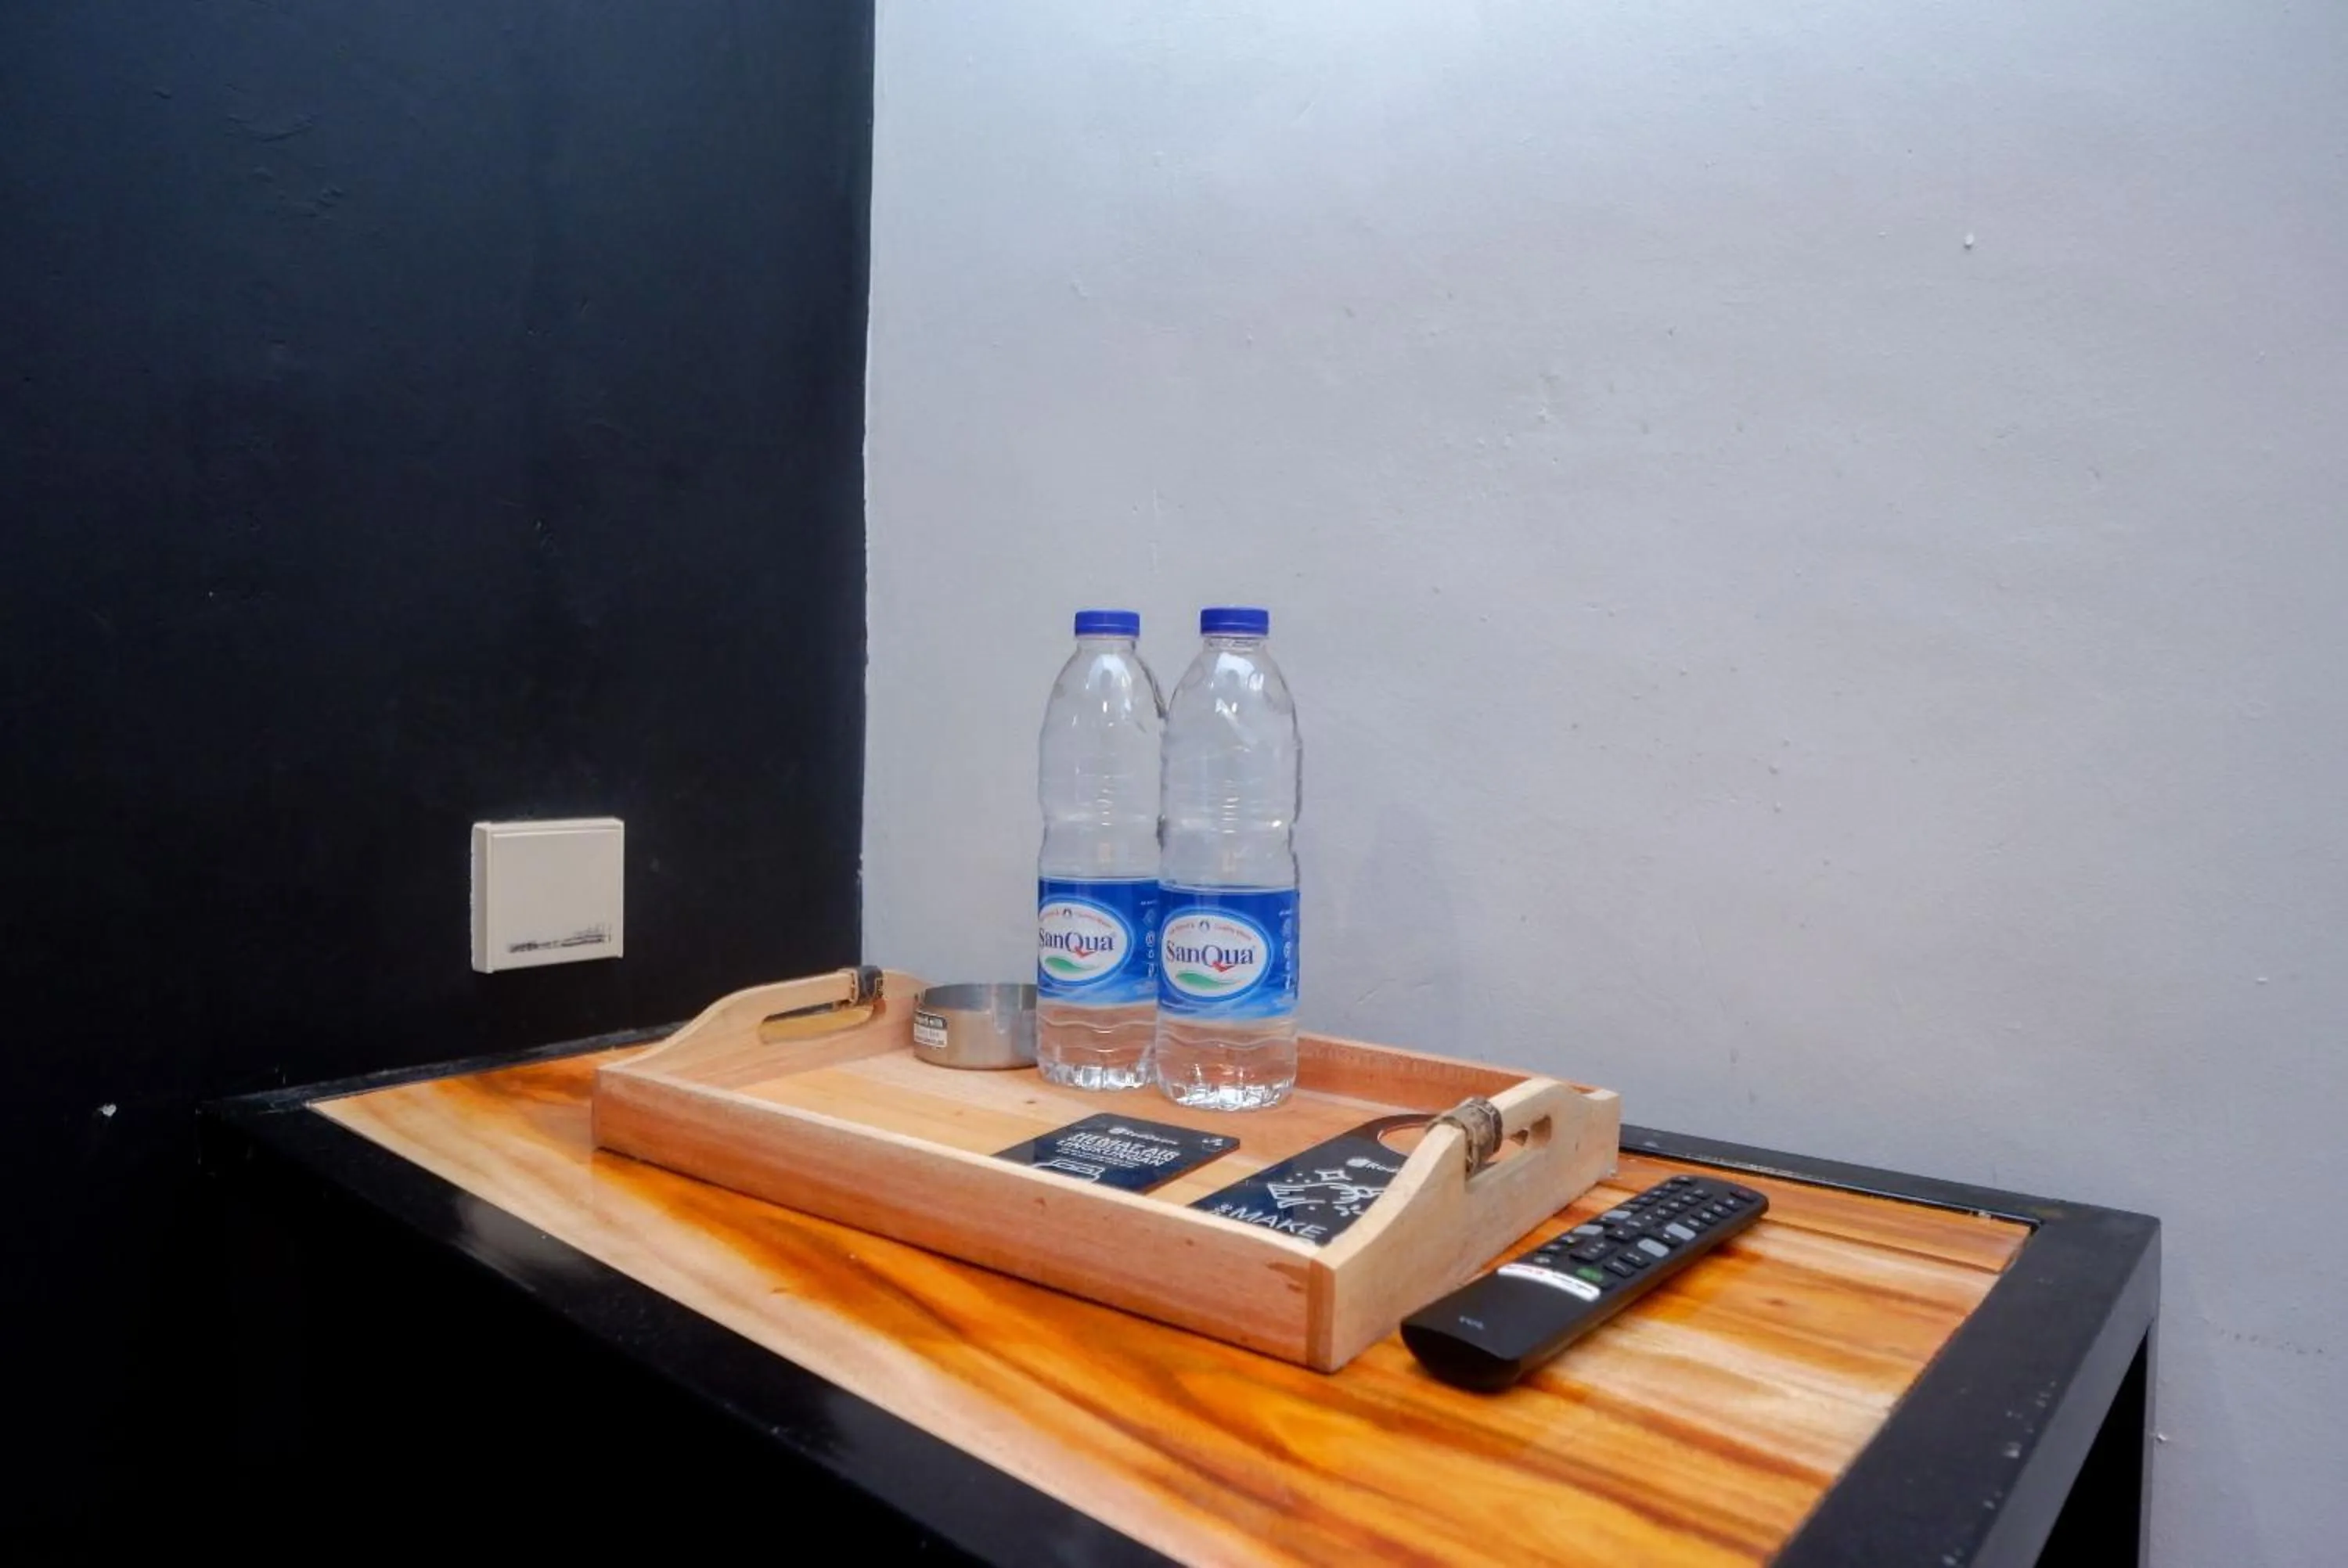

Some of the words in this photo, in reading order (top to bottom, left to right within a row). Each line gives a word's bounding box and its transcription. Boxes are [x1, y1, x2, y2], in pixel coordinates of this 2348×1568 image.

[1039, 927, 1115, 957] SanQua
[1166, 939, 1254, 971] SanQua
[1229, 1207, 1327, 1239] MAKE
